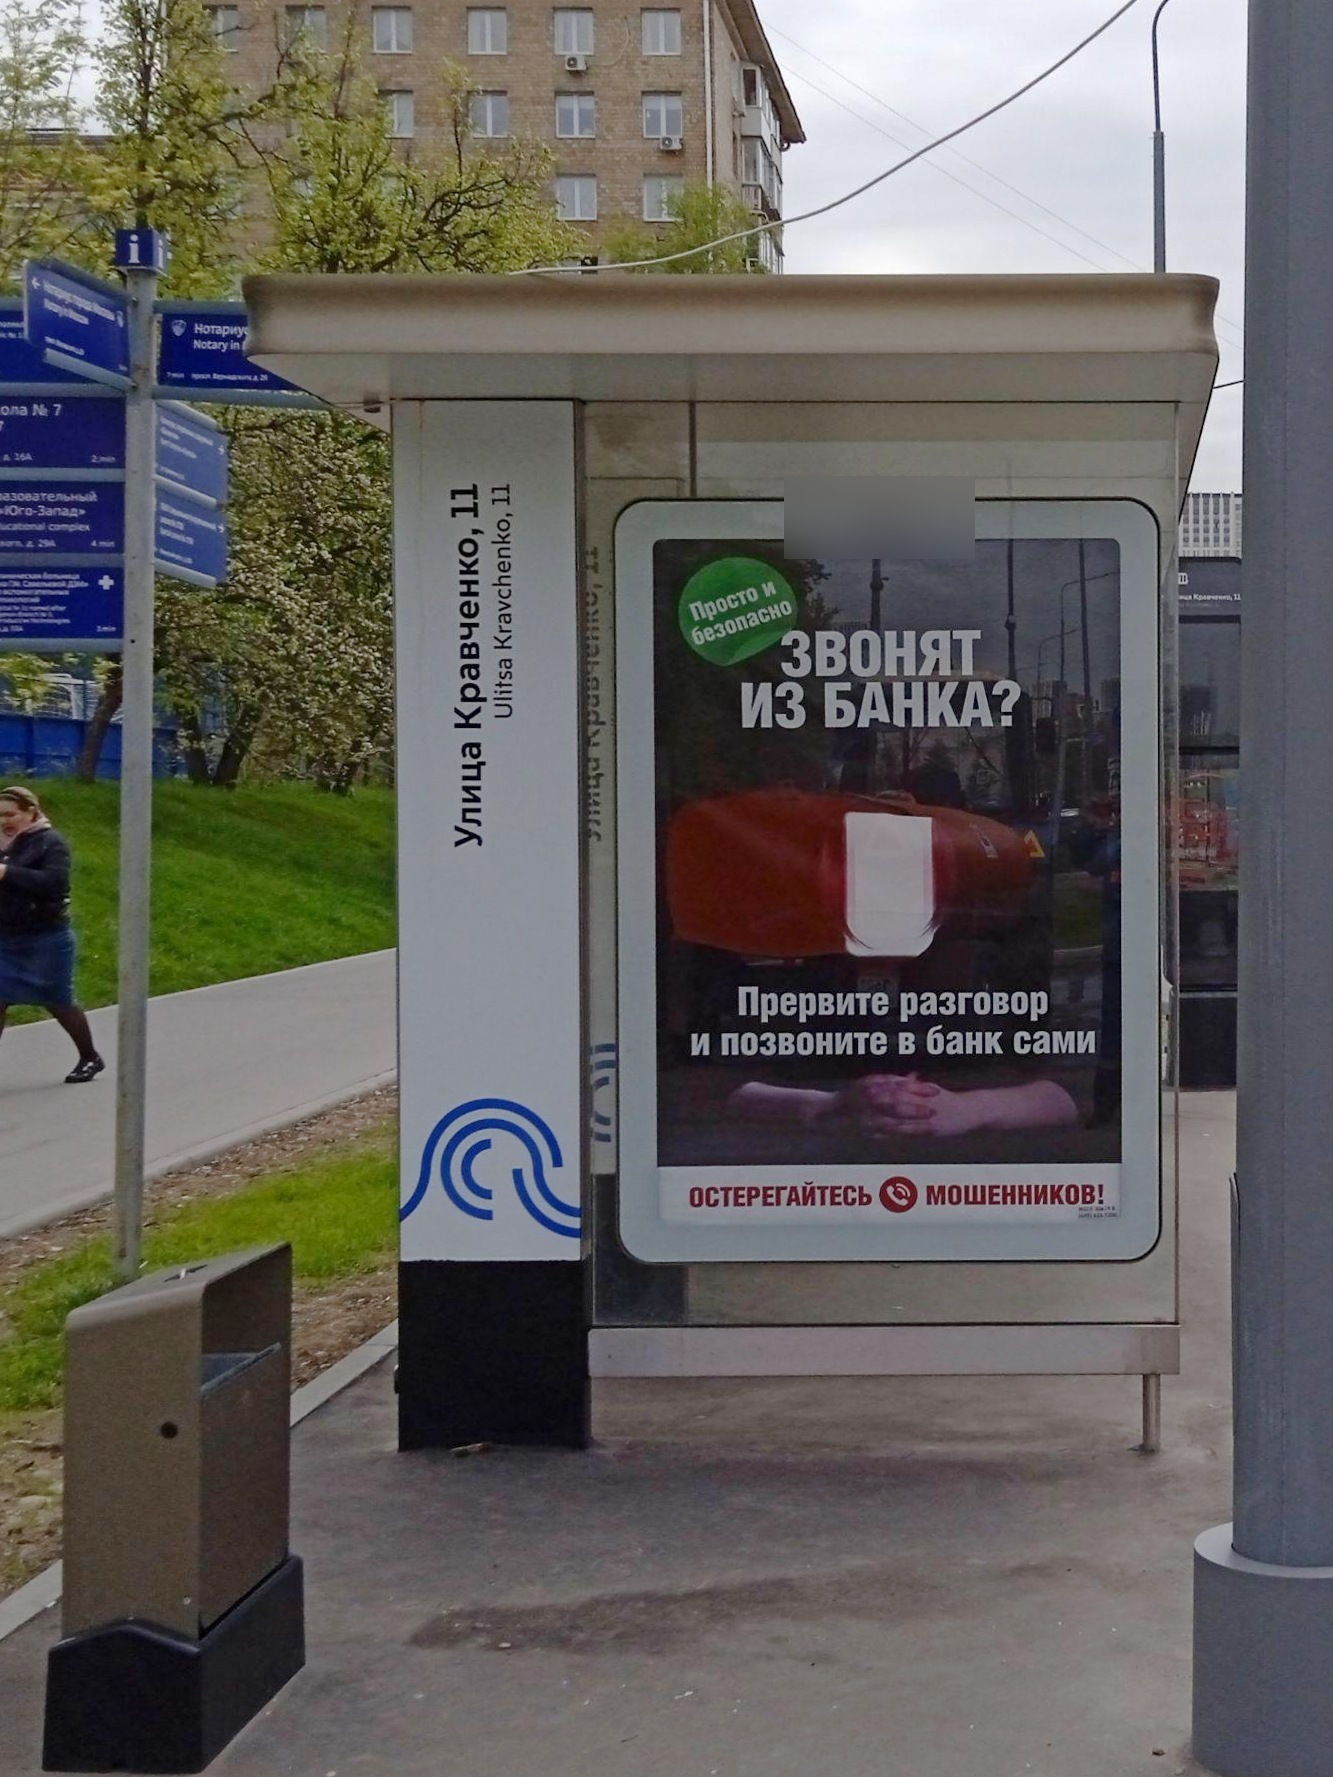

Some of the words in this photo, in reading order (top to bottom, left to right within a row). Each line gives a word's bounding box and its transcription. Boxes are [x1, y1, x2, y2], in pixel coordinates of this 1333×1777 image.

[193, 340, 228, 352] Notary
[230, 340, 240, 350] in
[0, 405, 28, 416] ола
[53, 404, 61, 416] 7
[451, 483, 479, 519] 11
[491, 484, 511, 506] 11
[491, 512, 513, 650] Kravchenko,
[688, 587, 759, 621] Просто
[761, 581, 777, 598] и
[454, 527, 487, 729] Кравченко,
[691, 600, 793, 645] безопасно
[781, 630, 982, 678] ЗВОНЯТ
[494, 658, 513, 718] Ulitsa
[741, 681, 807, 729] ИЗ
[824, 679, 1021, 729] БАНКА?
[454, 742, 486, 847] Улица
[738, 986, 889, 1023] Прервите
[900, 990, 1049, 1022] разговор
[691, 1032, 710, 1056] и
[721, 1031, 888, 1056] позвоните
[899, 1031, 915, 1055] в
[926, 1025, 1003, 1055] банк
[1013, 1029, 1096, 1054] сами
[689, 1181, 873, 1207] ОСТЕРЕГАЙТЕСЬ
[926, 1184, 1104, 1206] МОШЕННИКОВ!
